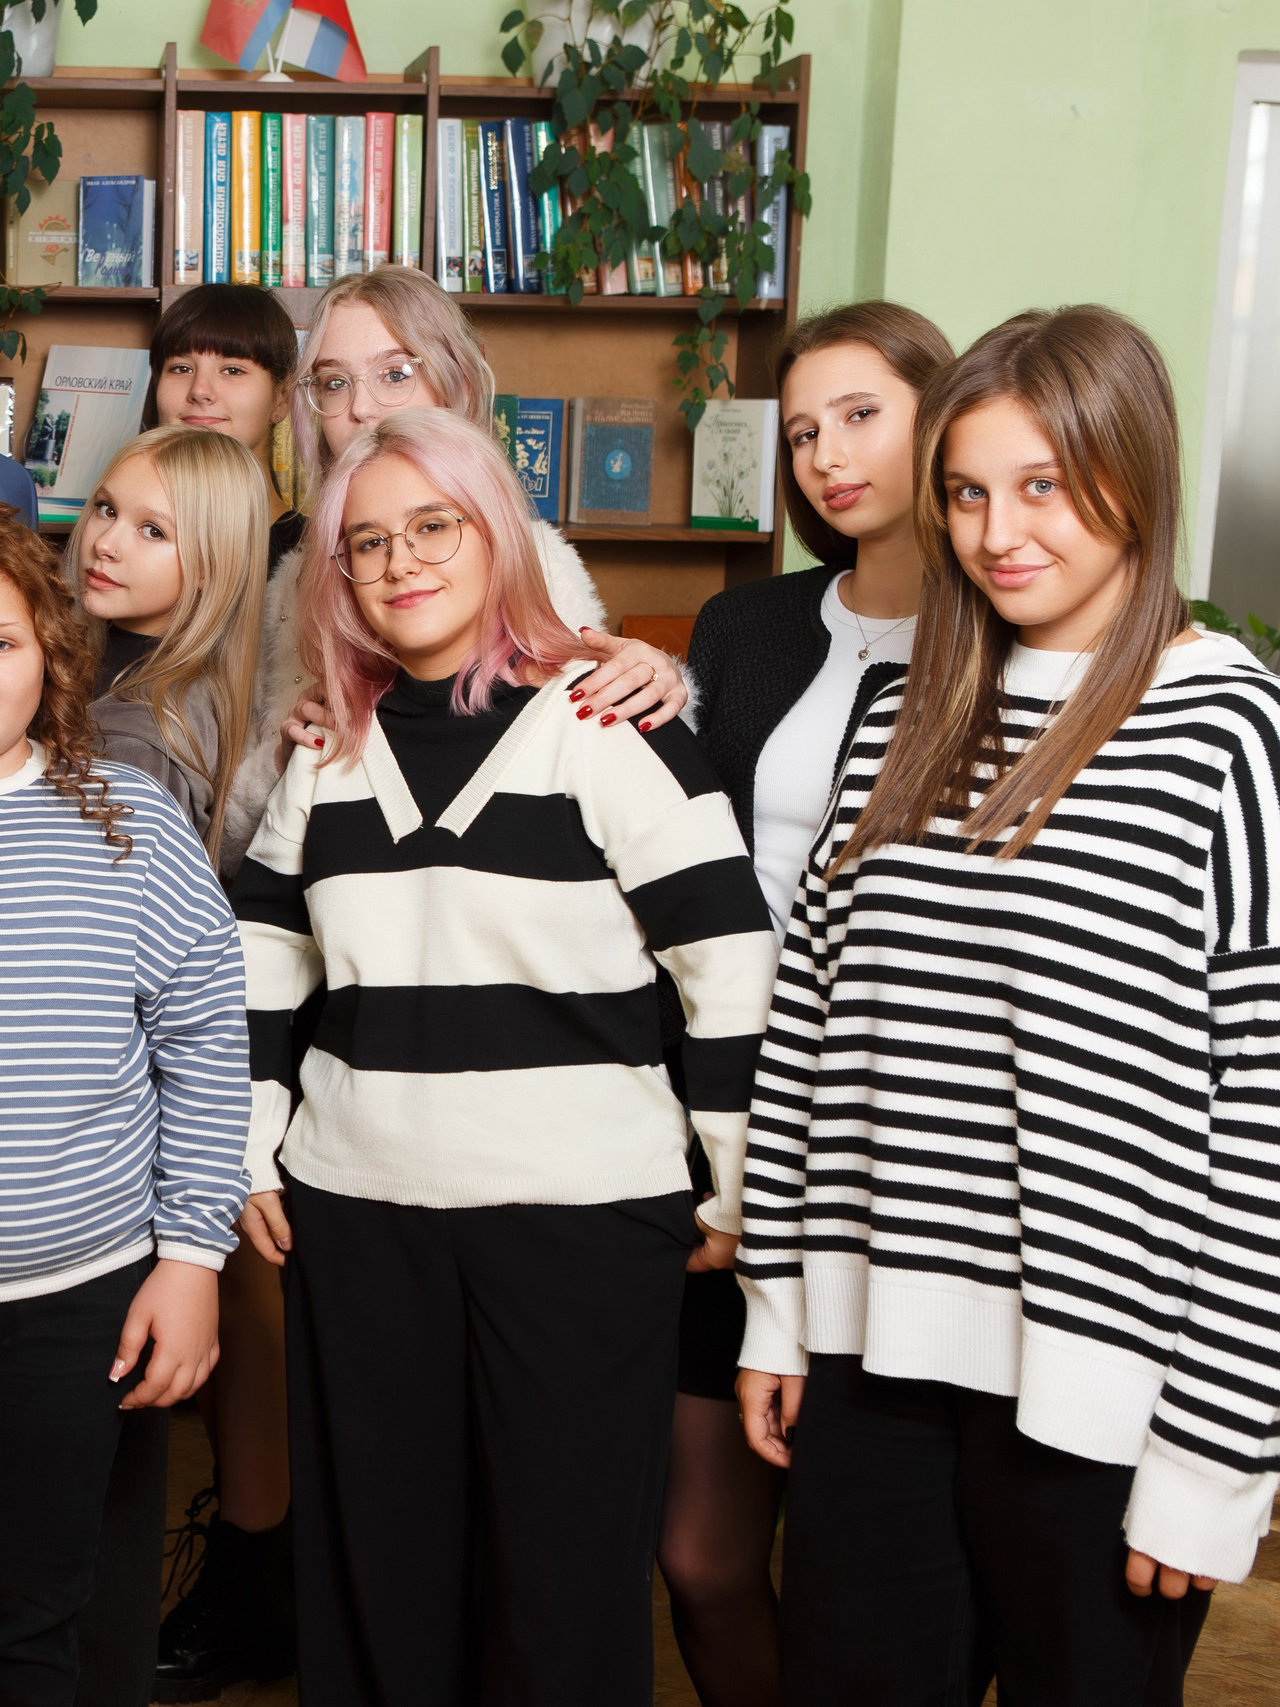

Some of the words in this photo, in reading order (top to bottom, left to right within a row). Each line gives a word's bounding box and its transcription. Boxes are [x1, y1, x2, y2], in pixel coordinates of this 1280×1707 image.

[217, 123, 227, 156] ДЕТЕЙ
[268, 119, 278, 147] ДЕТЕЙ
[293, 126, 302, 158] ДЕТЕЙ
[319, 123, 327, 151] ДЕТЕЙ
[374, 119, 384, 147] ДЕТЕЙ
[447, 125, 455, 152] ДЕТЕЙ
[185, 149, 193, 167] ДЛЯ
[217, 160, 226, 182] ДЛЯ
[293, 163, 302, 184] ДЛЯ
[319, 155, 327, 172] ДЛЯ
[374, 152, 383, 169] ДЛЯ
[470, 149, 478, 194] ПИТОМЦЫ
[373, 173, 382, 245] ЭНЦИКЛОПЕДИЯ
[409, 170, 417, 218] ЧЕЛОВЕКА
[318, 176, 327, 248] ЭНЦИКЛОПЕДИЯ
[448, 177, 456, 249] ЭНЦИКЛОПЕДИЯ
[471, 195, 480, 247] ДОМАШНИЕ
[494, 192, 502, 246] ИНФОРМАТИКА
[215, 186, 225, 273] ЭНЦИКЛОПЕДИЯ
[291, 189, 301, 276] ЭНЦИКЛОПЕДИЯ
[55, 376, 108, 389] ОРЛОВСКИЙ
[108, 378, 133, 391] КРАЙ
